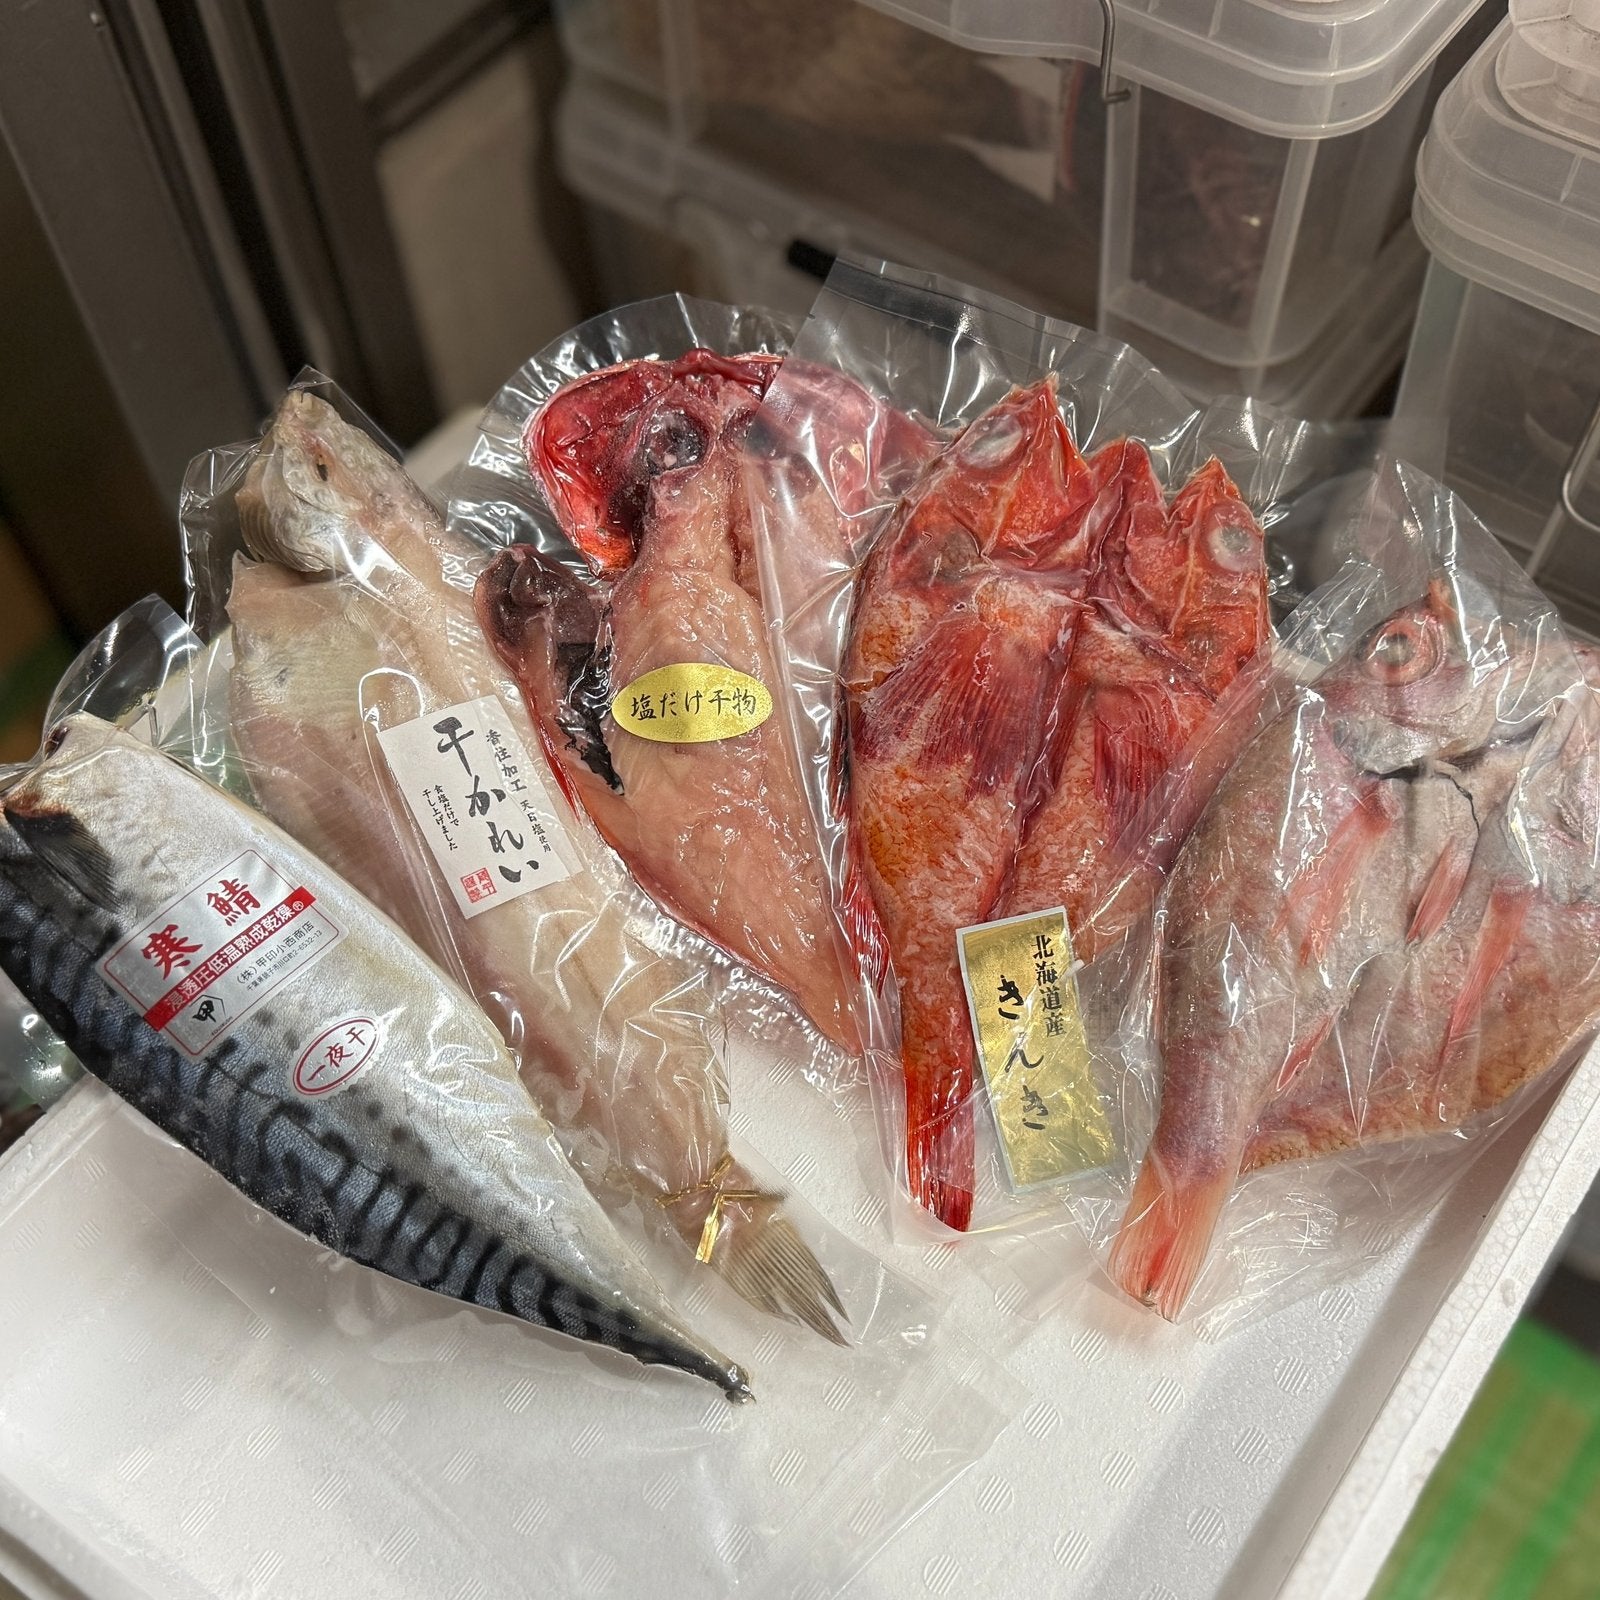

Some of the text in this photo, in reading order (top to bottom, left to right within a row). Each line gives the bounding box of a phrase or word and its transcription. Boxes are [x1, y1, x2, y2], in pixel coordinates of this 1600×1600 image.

[630, 687, 757, 721] 塩だけ干物
[485, 728, 528, 794] 香住加工
[421, 788, 459, 851] 干し上げました
[432, 716, 540, 883] 干かれい
[433, 784, 460, 828] 食塩だけで
[519, 798, 552, 853] 天日塩使用
[1030, 934, 1067, 1036] 北海道産
[306, 1026, 368, 1083] 一夜干
[996, 974, 1050, 1132] きんき
